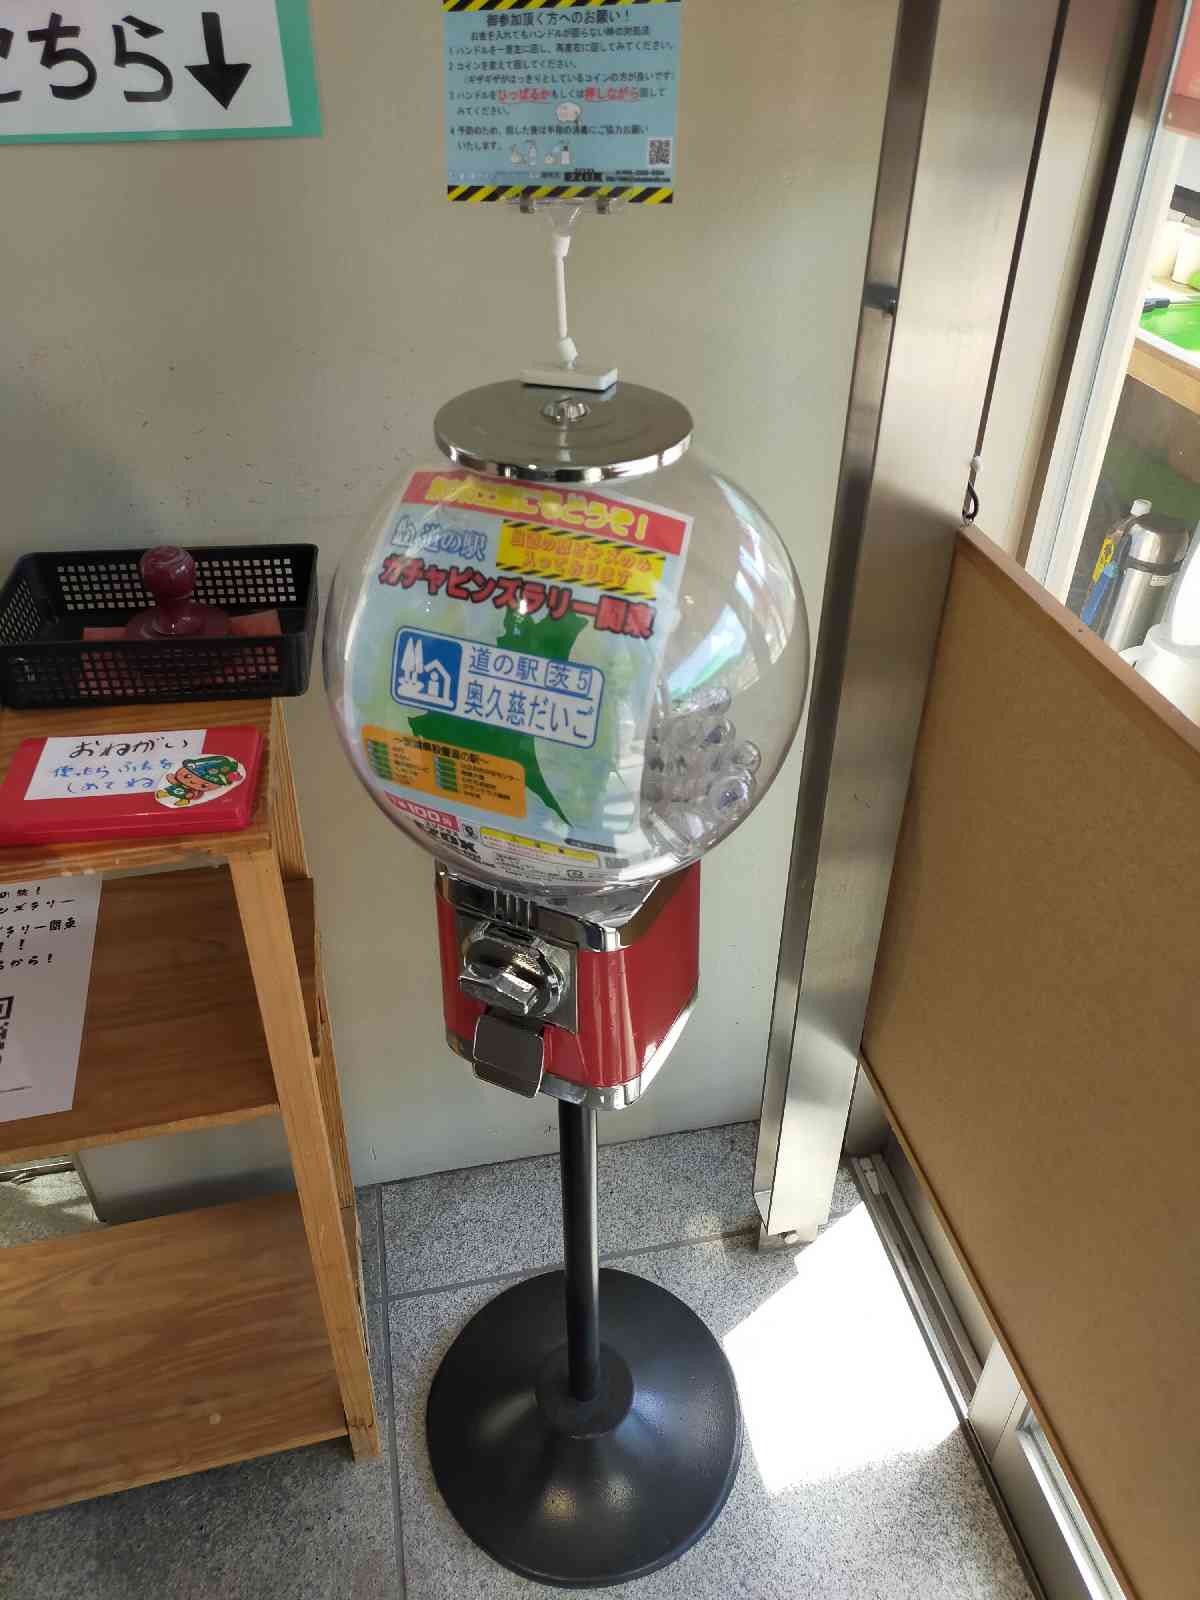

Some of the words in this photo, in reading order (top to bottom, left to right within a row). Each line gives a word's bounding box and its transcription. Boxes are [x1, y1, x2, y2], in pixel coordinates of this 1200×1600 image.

[468, 646, 539, 683] 道の駅
[463, 680, 594, 740] 奥久慈だいご
[69, 737, 189, 759] おねがい
[0, 916, 78, 938] ラリー関東
